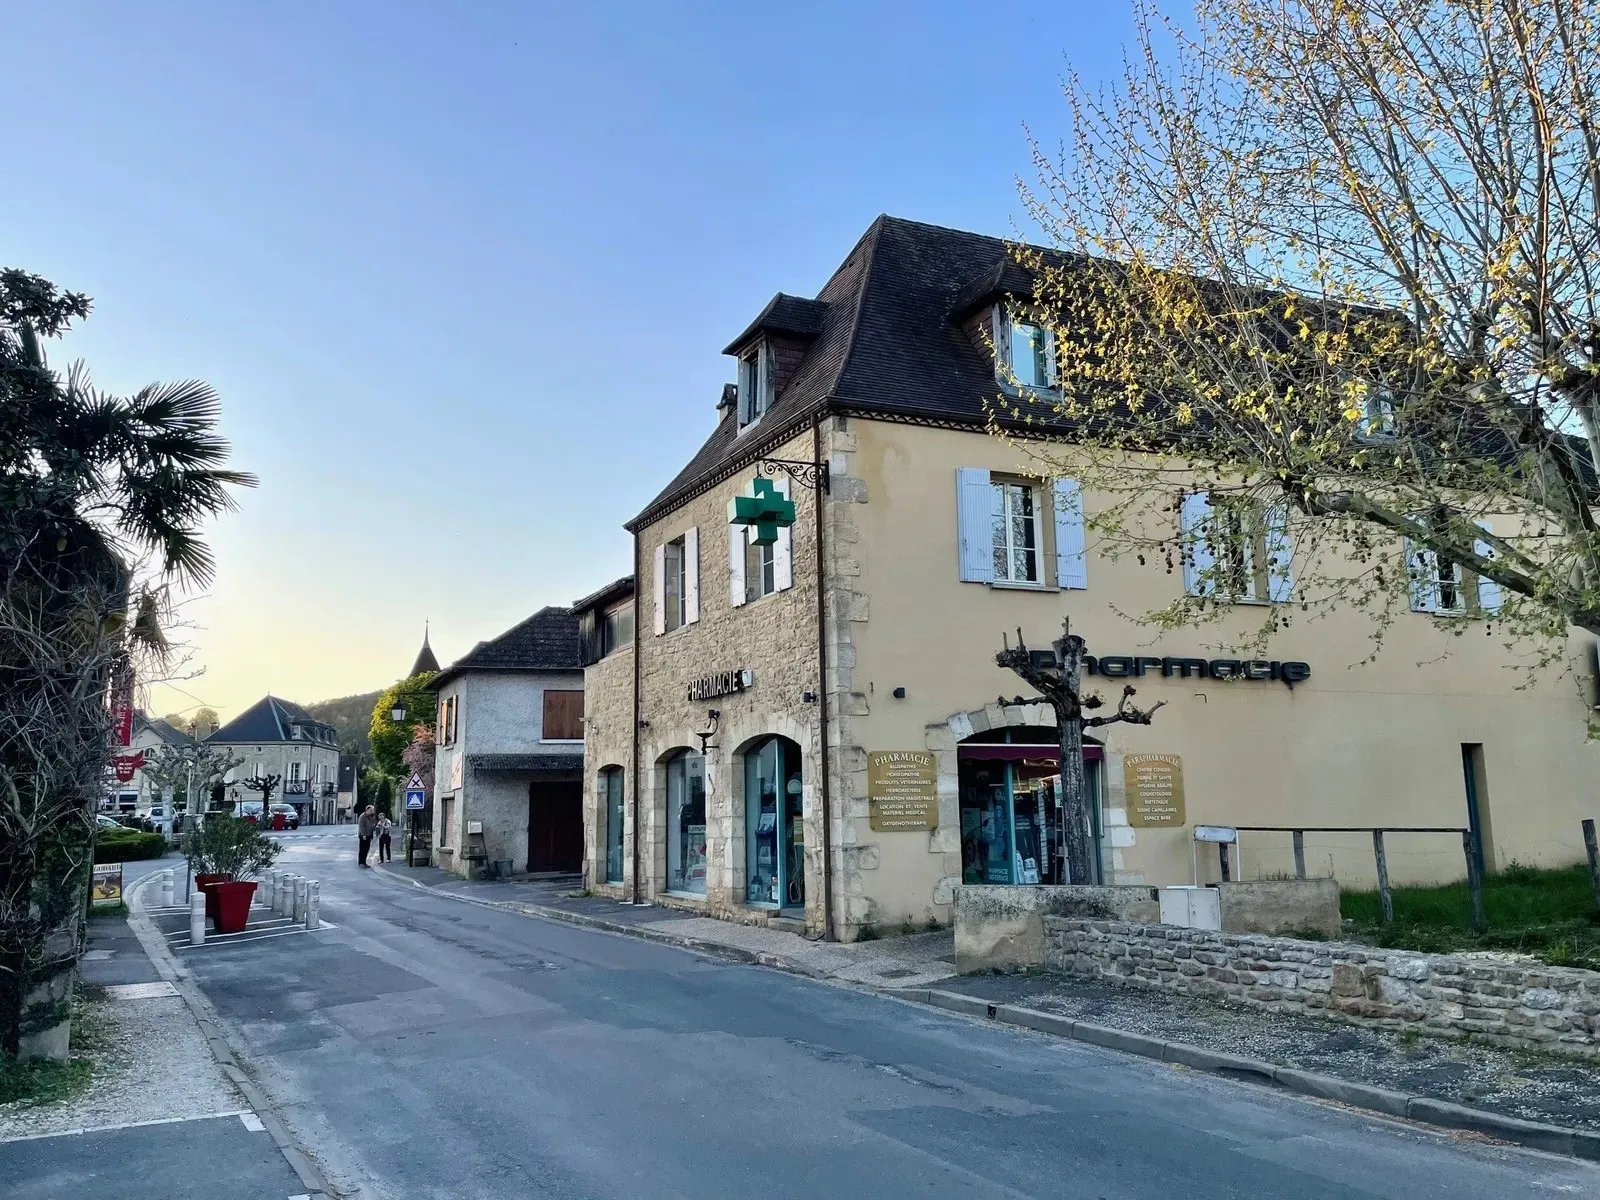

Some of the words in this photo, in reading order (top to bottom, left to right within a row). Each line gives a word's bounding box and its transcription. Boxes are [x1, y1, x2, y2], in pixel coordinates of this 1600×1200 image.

[687, 670, 740, 701] PHARMACIE
[874, 753, 930, 766] PHARMACIE
[1126, 754, 1180, 767] PARAPHARMACIE
